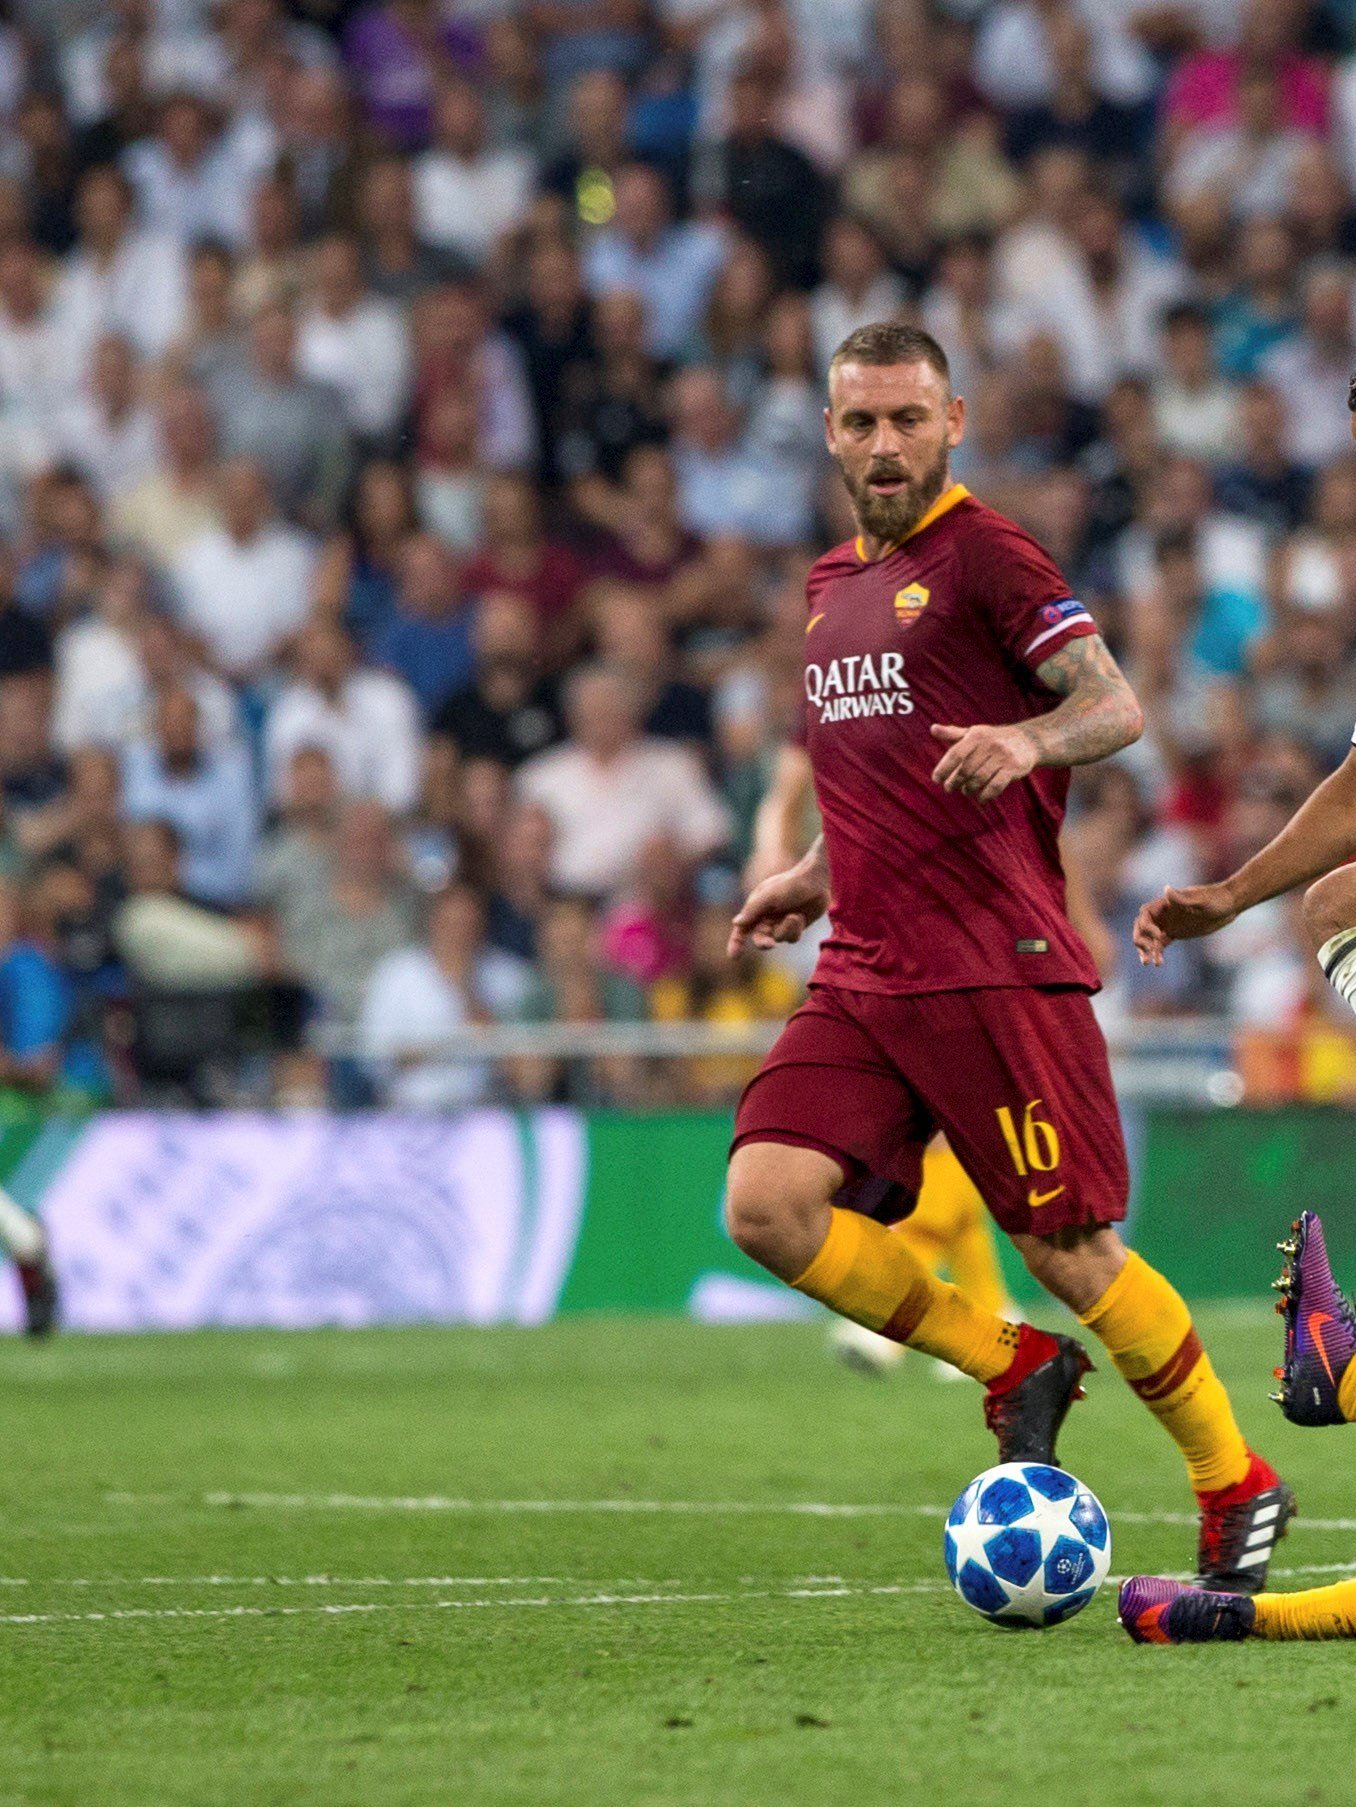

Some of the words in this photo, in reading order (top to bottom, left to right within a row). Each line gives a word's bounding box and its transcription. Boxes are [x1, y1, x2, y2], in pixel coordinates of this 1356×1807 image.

[804, 652, 909, 707] QATAR
[820, 691, 914, 724] AIRWAYS
[995, 1099, 1060, 1176] 16
